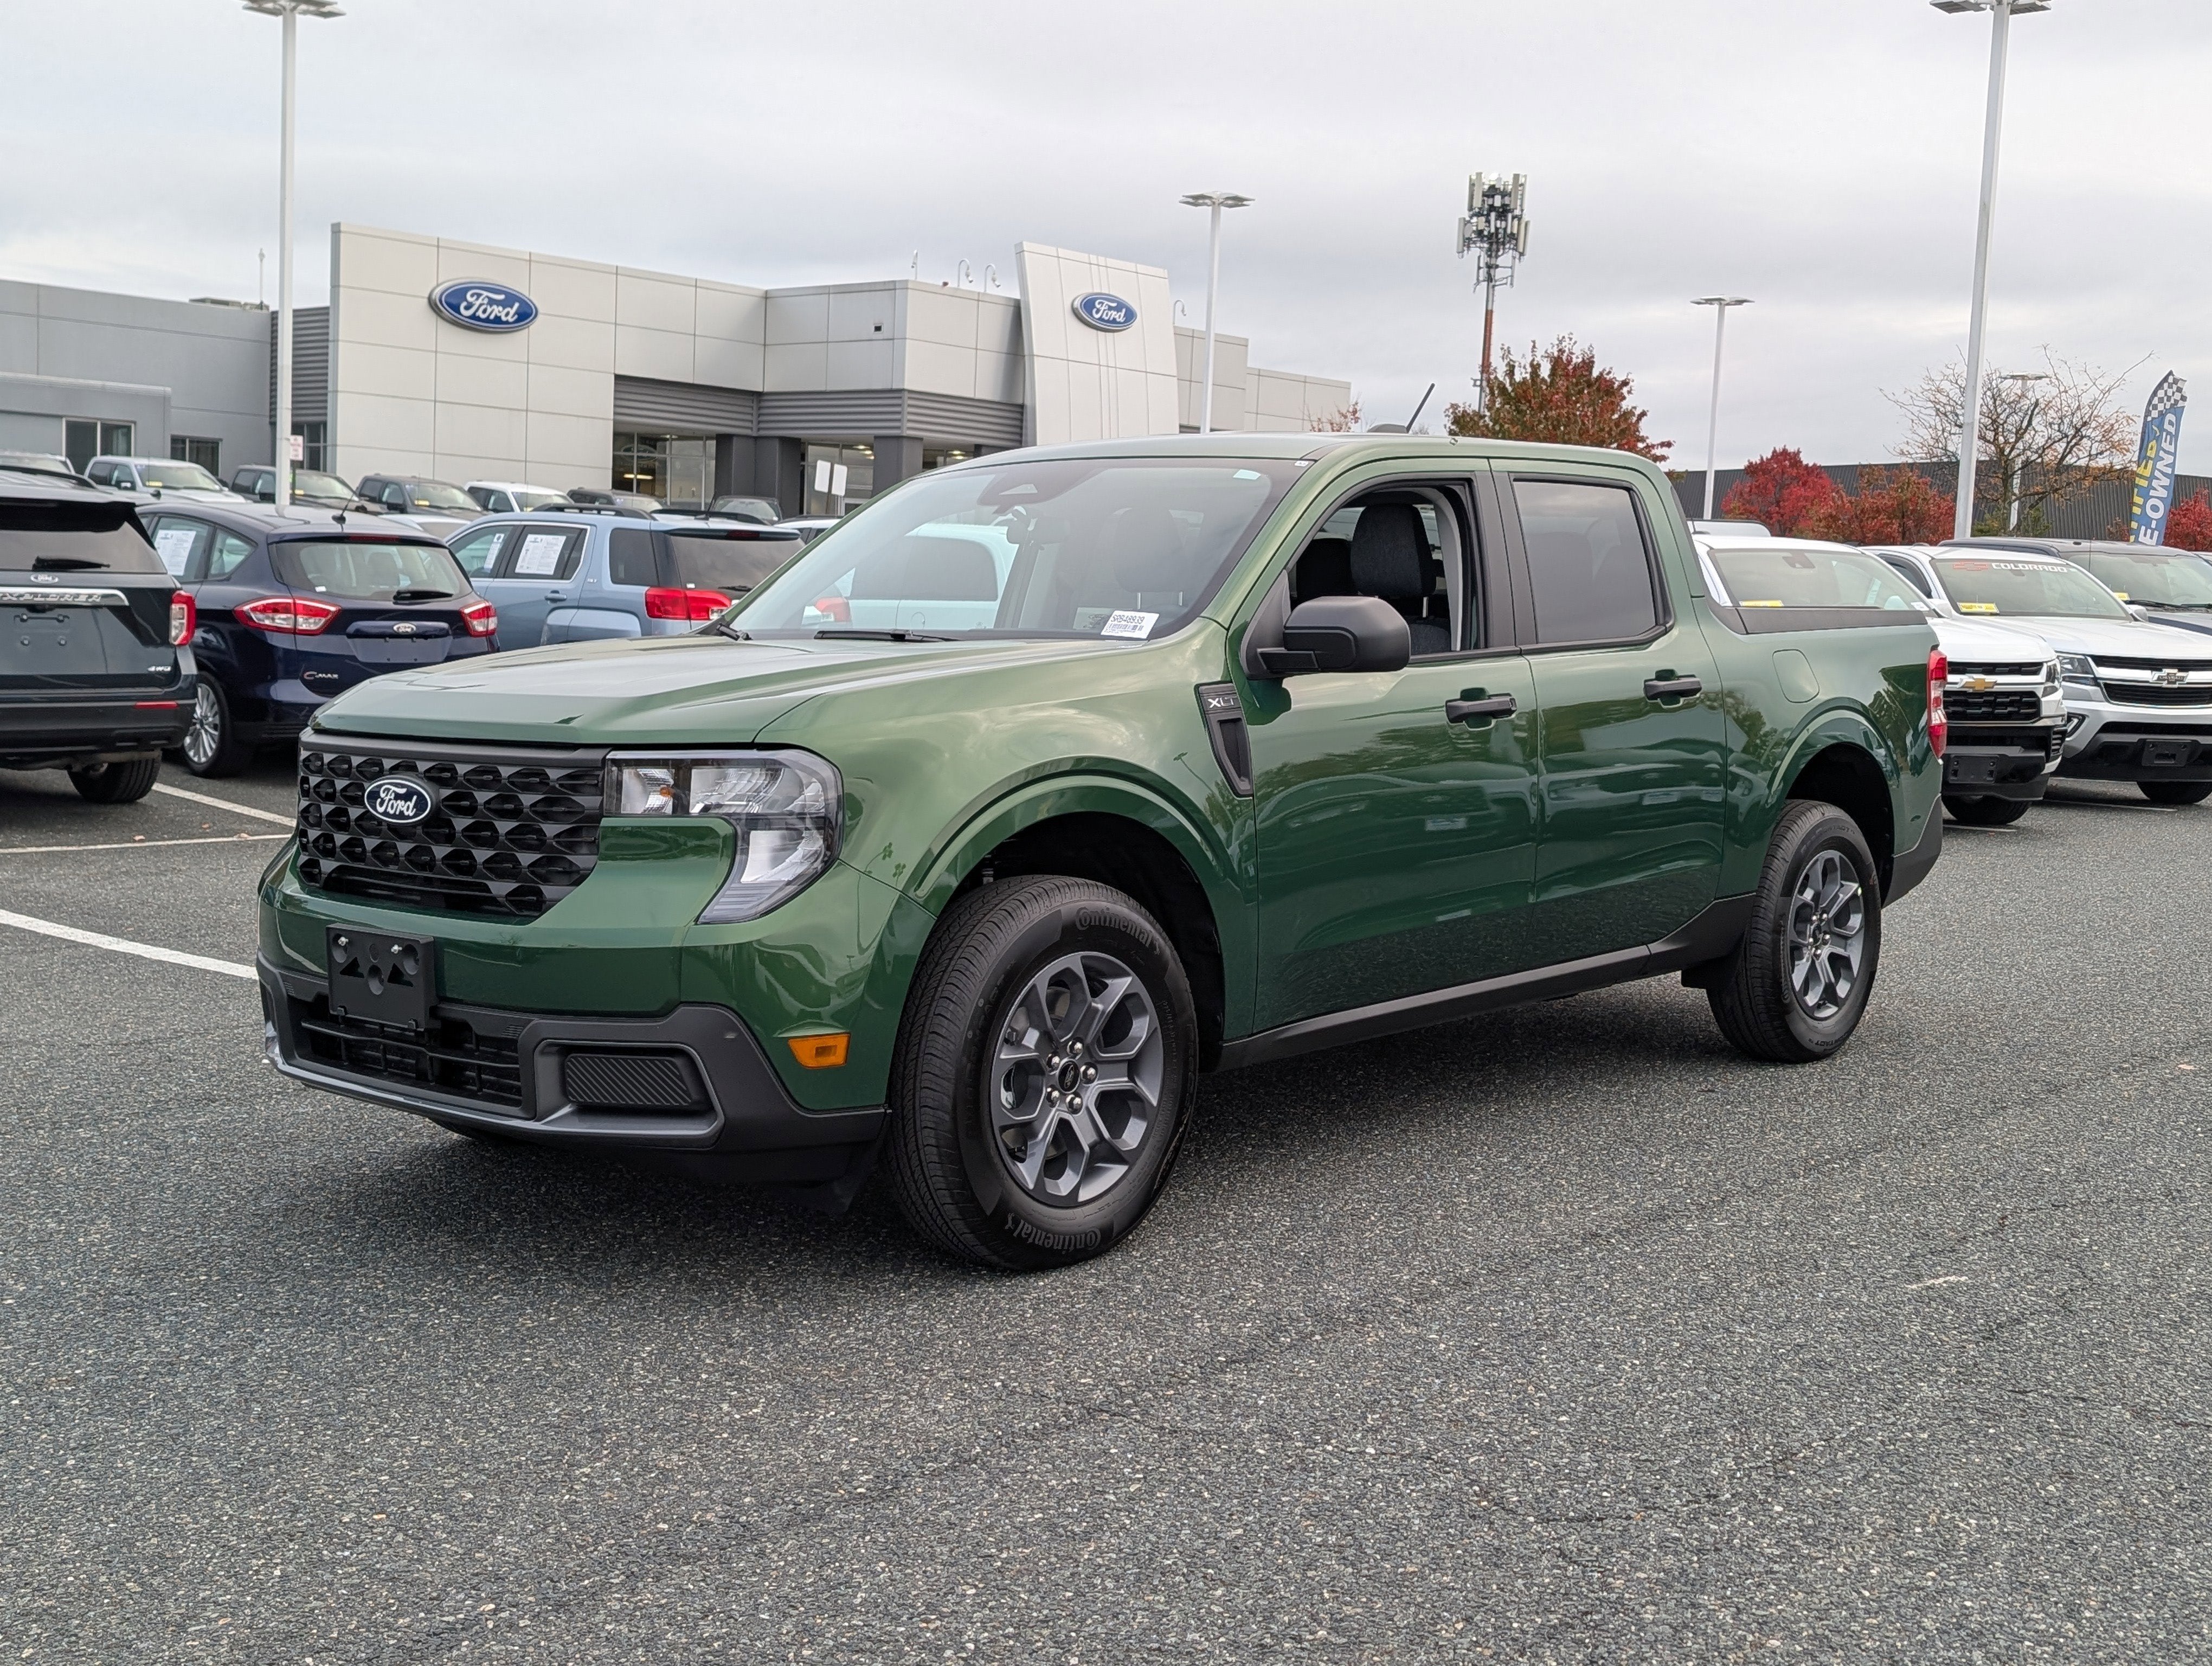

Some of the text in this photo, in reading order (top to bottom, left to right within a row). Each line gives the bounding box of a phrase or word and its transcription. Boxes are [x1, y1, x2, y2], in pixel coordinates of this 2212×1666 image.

[460, 289, 518, 322] Ford
[1092, 299, 1126, 322] Ford
[1991, 562, 2068, 573] COLORADO
[0, 593, 102, 602] XPLORER
[1207, 697, 1234, 708] XLT
[376, 784, 417, 817] Ford
[1075, 906, 1153, 948] Continental
[1013, 1219, 1101, 1255] Continental
